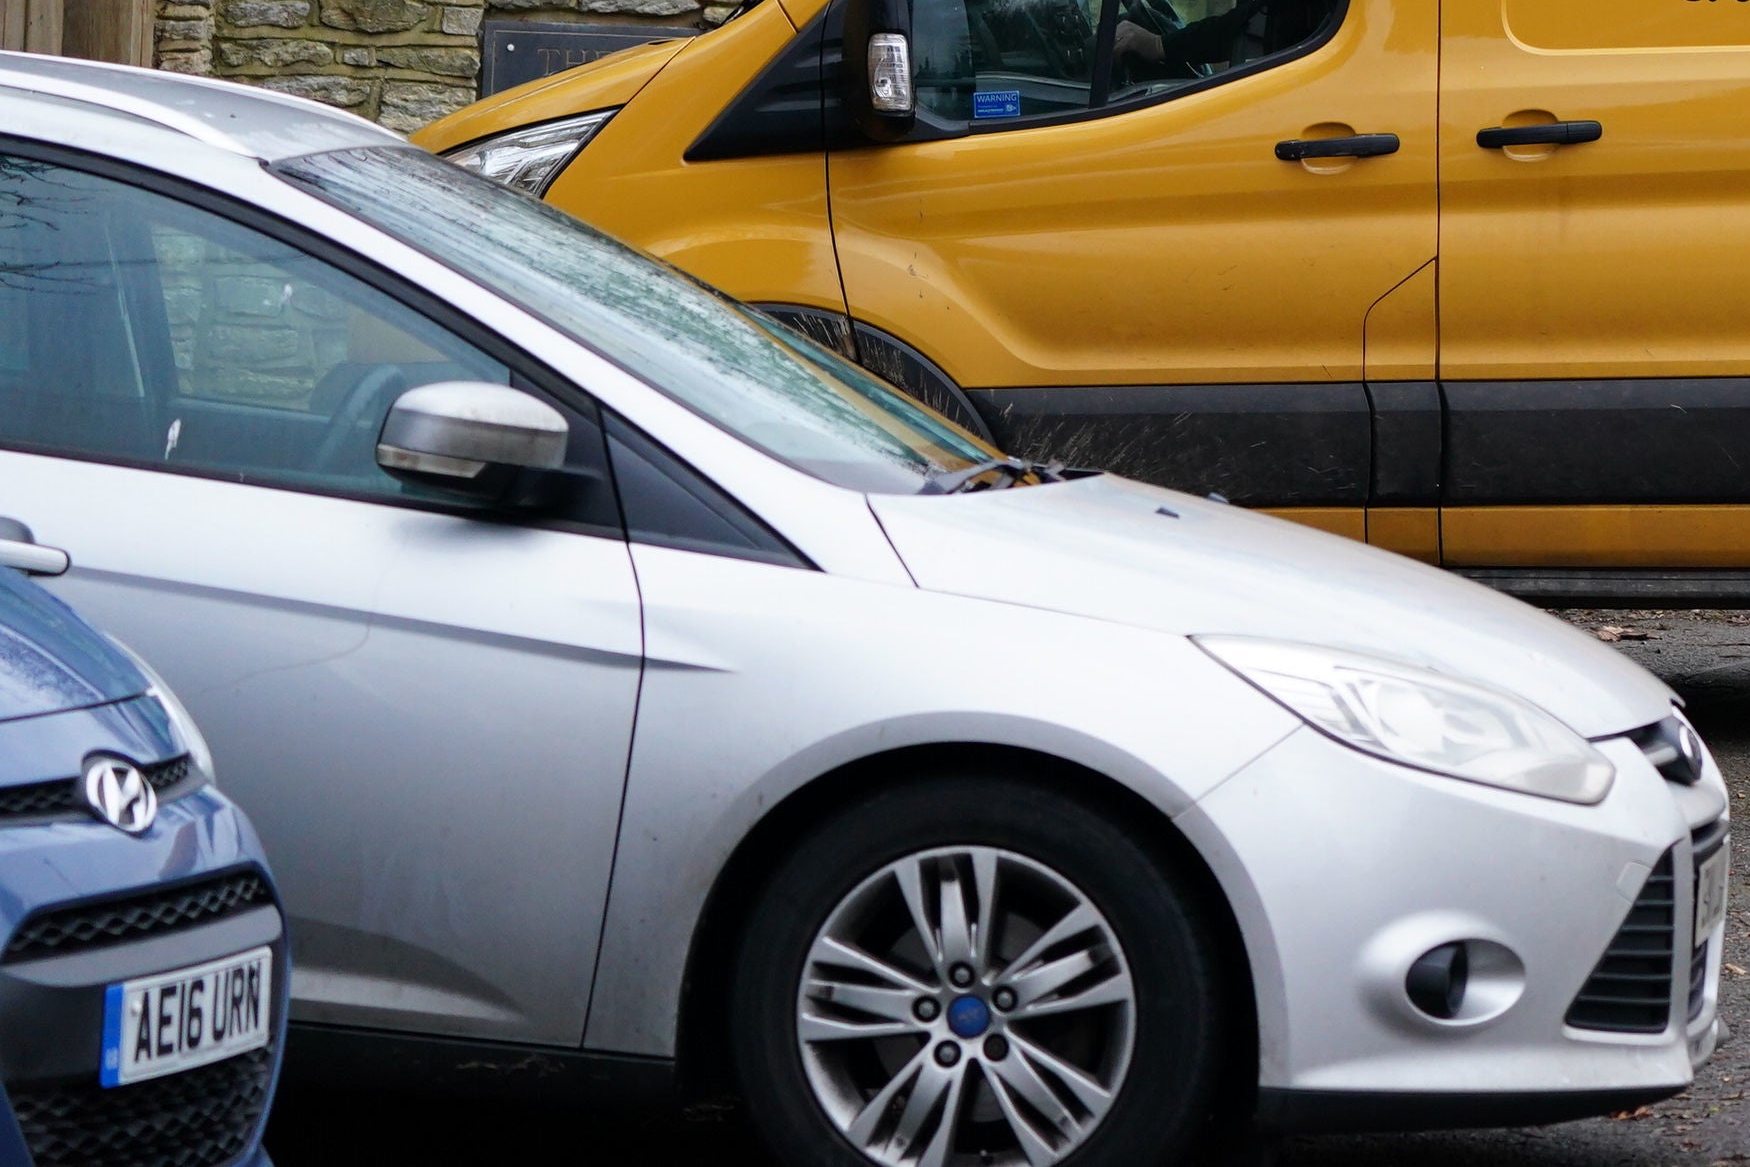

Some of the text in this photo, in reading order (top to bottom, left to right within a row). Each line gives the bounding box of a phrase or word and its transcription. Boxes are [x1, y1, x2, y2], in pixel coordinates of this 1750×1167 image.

[976, 93, 1017, 103] WARNING
[134, 958, 262, 1064] AE16 URN
